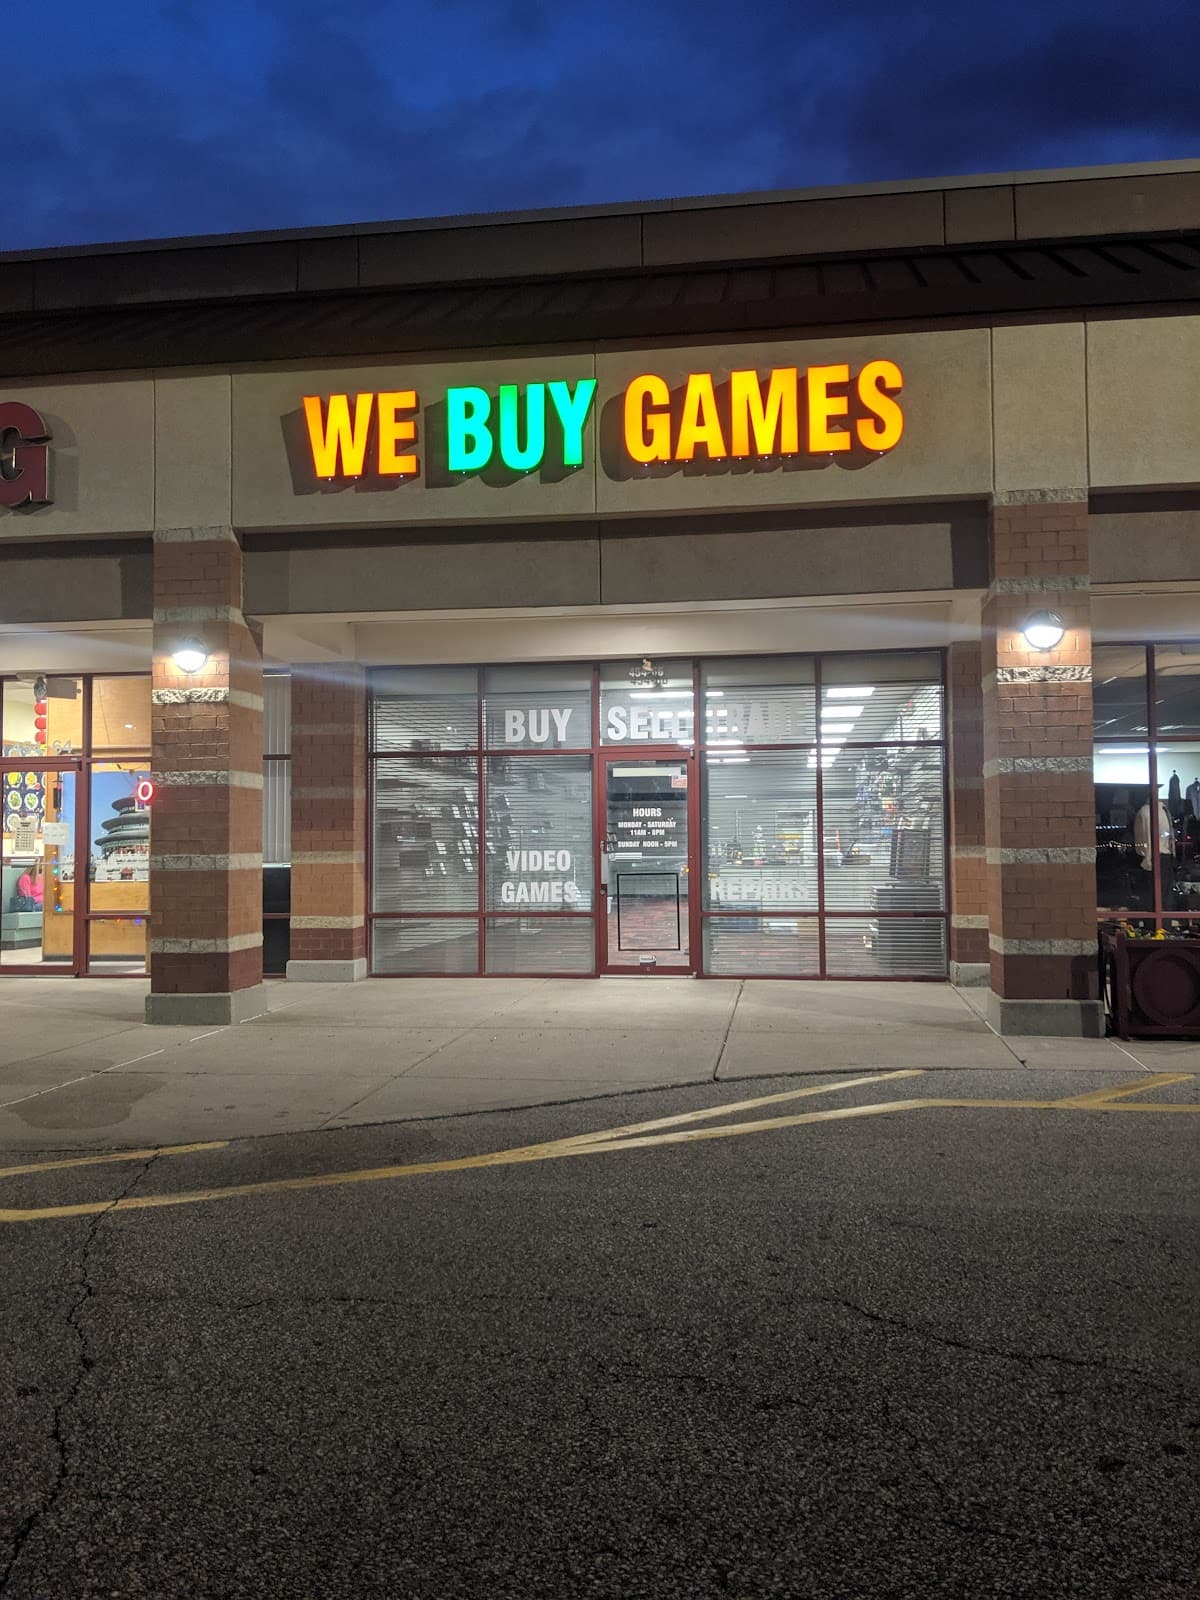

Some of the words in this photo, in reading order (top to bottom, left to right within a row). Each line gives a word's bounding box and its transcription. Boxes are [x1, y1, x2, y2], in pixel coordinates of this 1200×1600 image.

[303, 389, 418, 478] WE
[446, 378, 597, 472] BUY
[624, 360, 904, 464] GAMES
[505, 709, 572, 743] BUY
[607, 706, 689, 741] SELL
[632, 808, 662, 817] HOURS
[506, 850, 571, 871] VIDEO
[501, 881, 576, 902] GAMES
[710, 879, 807, 900] REPAIRS
